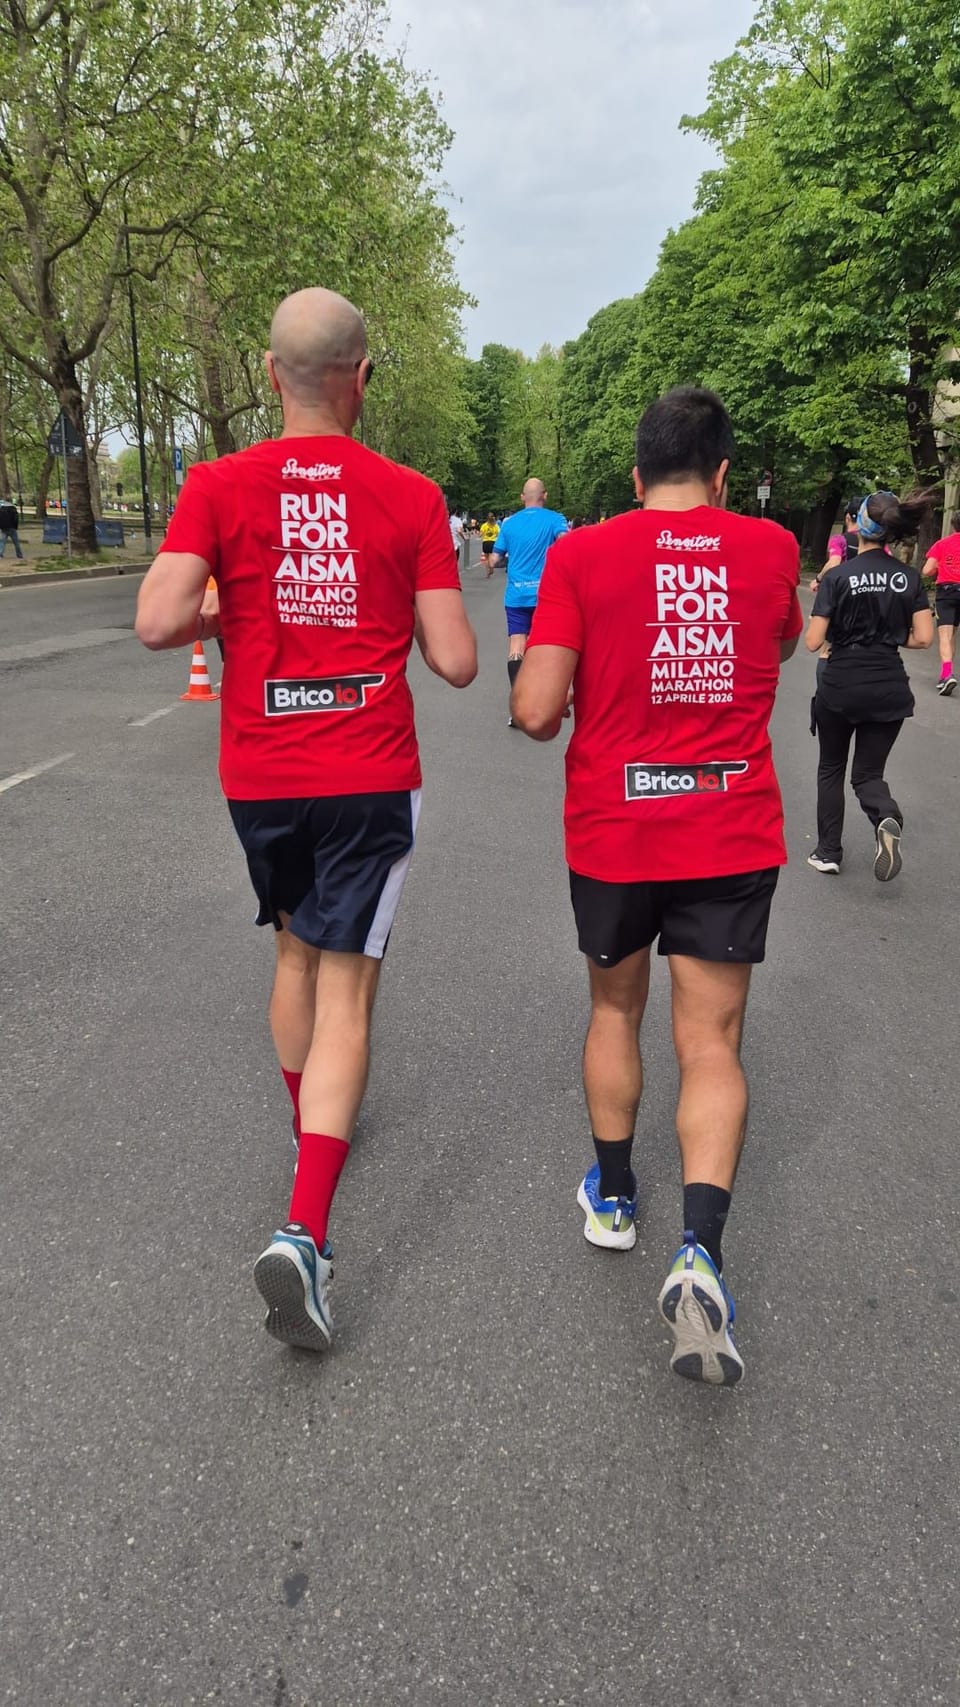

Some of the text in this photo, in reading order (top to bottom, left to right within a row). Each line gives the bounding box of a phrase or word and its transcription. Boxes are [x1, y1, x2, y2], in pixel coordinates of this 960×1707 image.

[175, 450, 181, 469] P
[280, 493, 346, 521] RUN
[281, 520, 349, 549] FOR
[274, 553, 357, 582] AISM
[655, 564, 728, 592] RUN
[849, 572, 887, 589] BAIN
[276, 583, 358, 603] MILANO
[277, 601, 358, 616] MARATHON
[656, 591, 729, 622] FOR
[279, 613, 358, 628] 12 APRILE 2026
[650, 626, 735, 657] AISM
[651, 660, 735, 680] MILANO
[651, 678, 734, 693] MARATHON
[651, 692, 733, 705] 12 APRILE 2026
